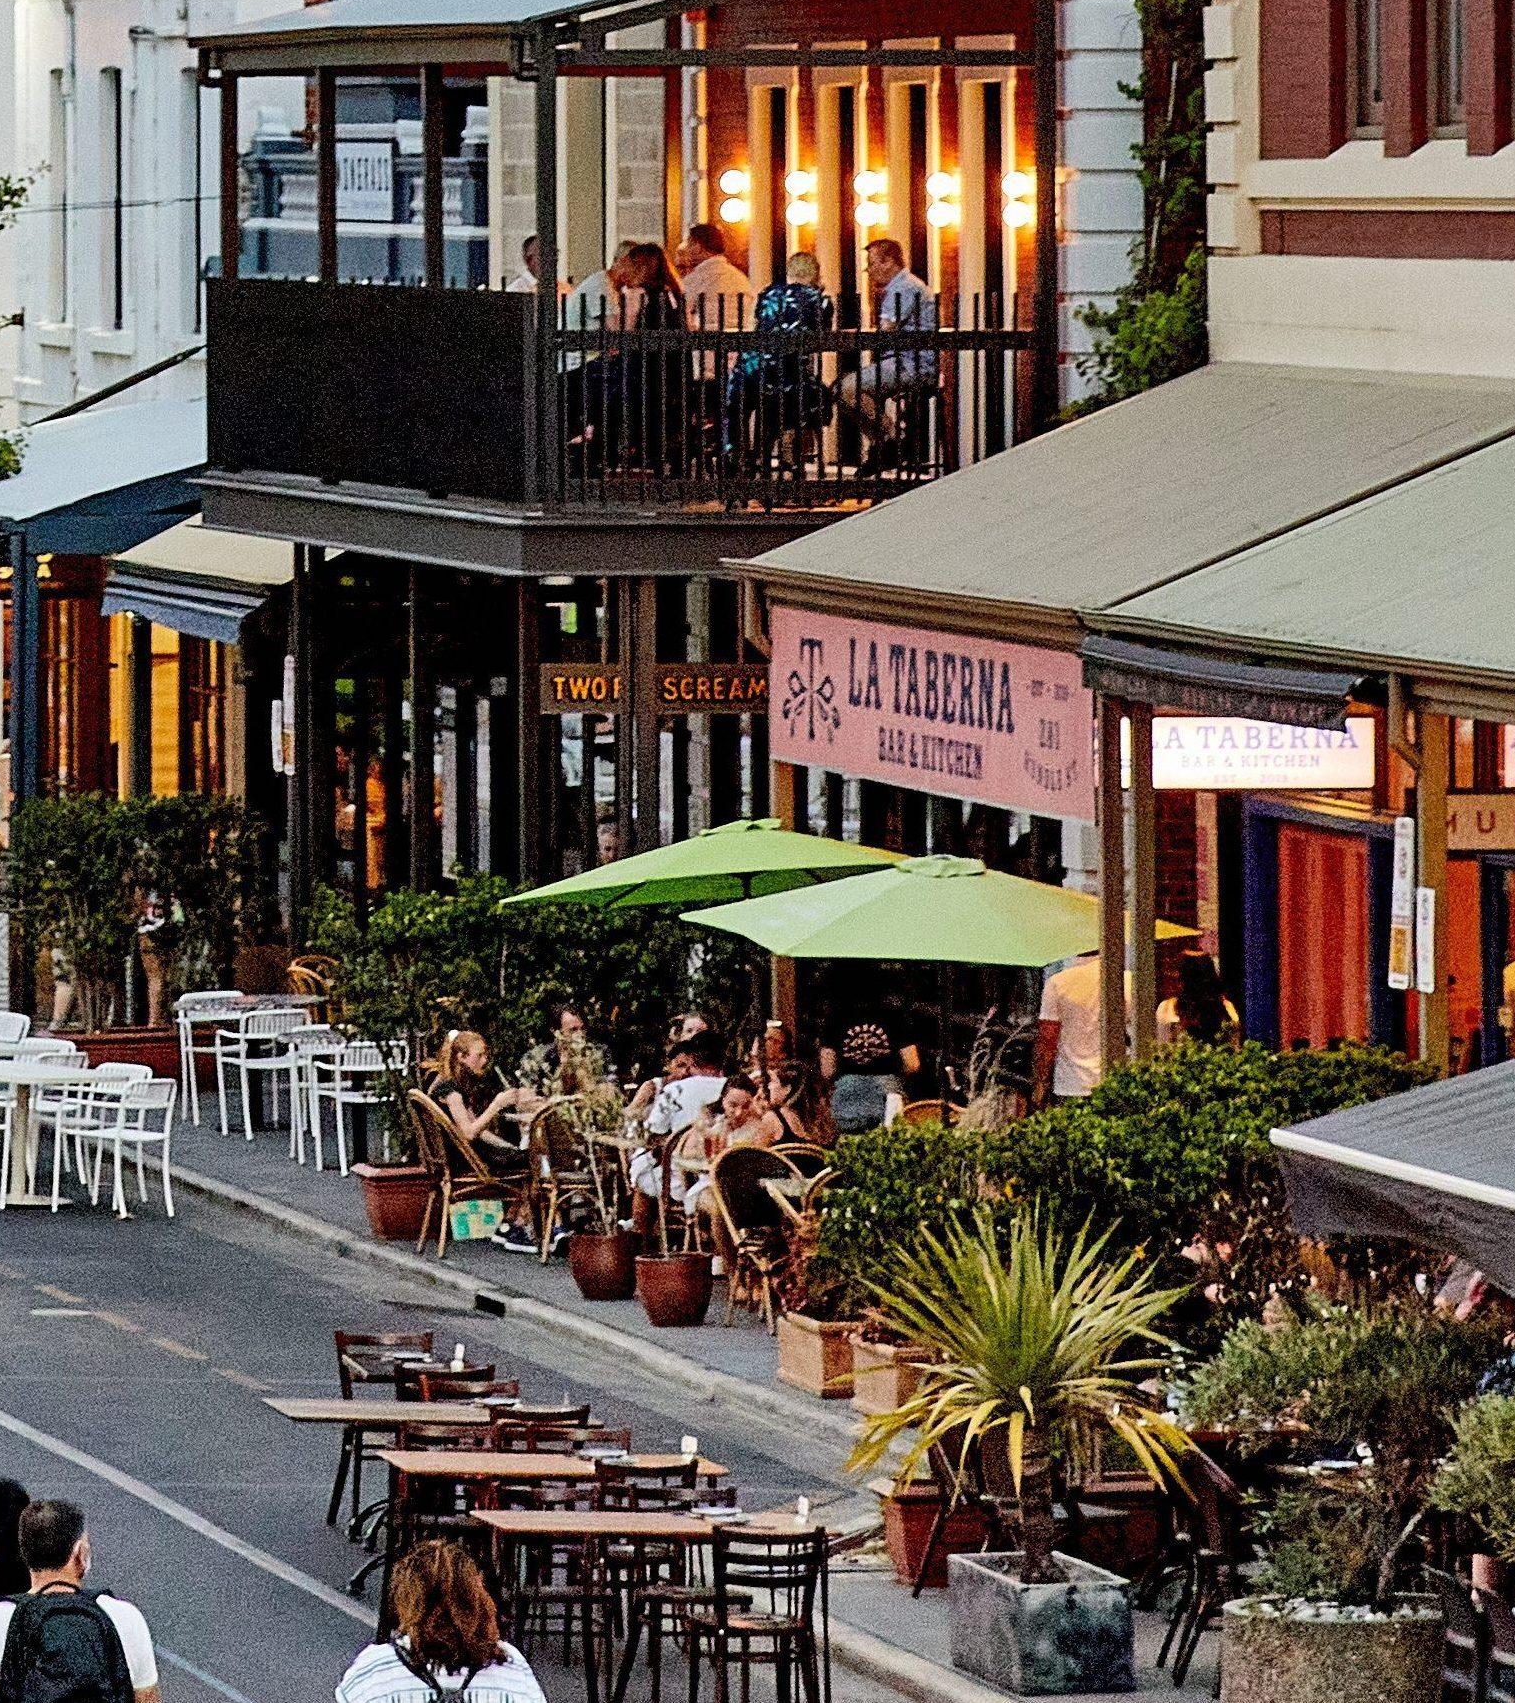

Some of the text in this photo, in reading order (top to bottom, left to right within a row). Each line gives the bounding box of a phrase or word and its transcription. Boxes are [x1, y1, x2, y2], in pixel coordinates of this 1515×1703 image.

[553, 676, 609, 700] TWO
[663, 676, 767, 700] SCREAM
[848, 636, 882, 710] LA
[888, 643, 1014, 733] TABERNA
[1197, 725, 1359, 749] TABERNA
[878, 726, 983, 781] BAR & KITCHEN
[1181, 754, 1216, 768] BAR
[1240, 754, 1320, 768] KITCHEN
